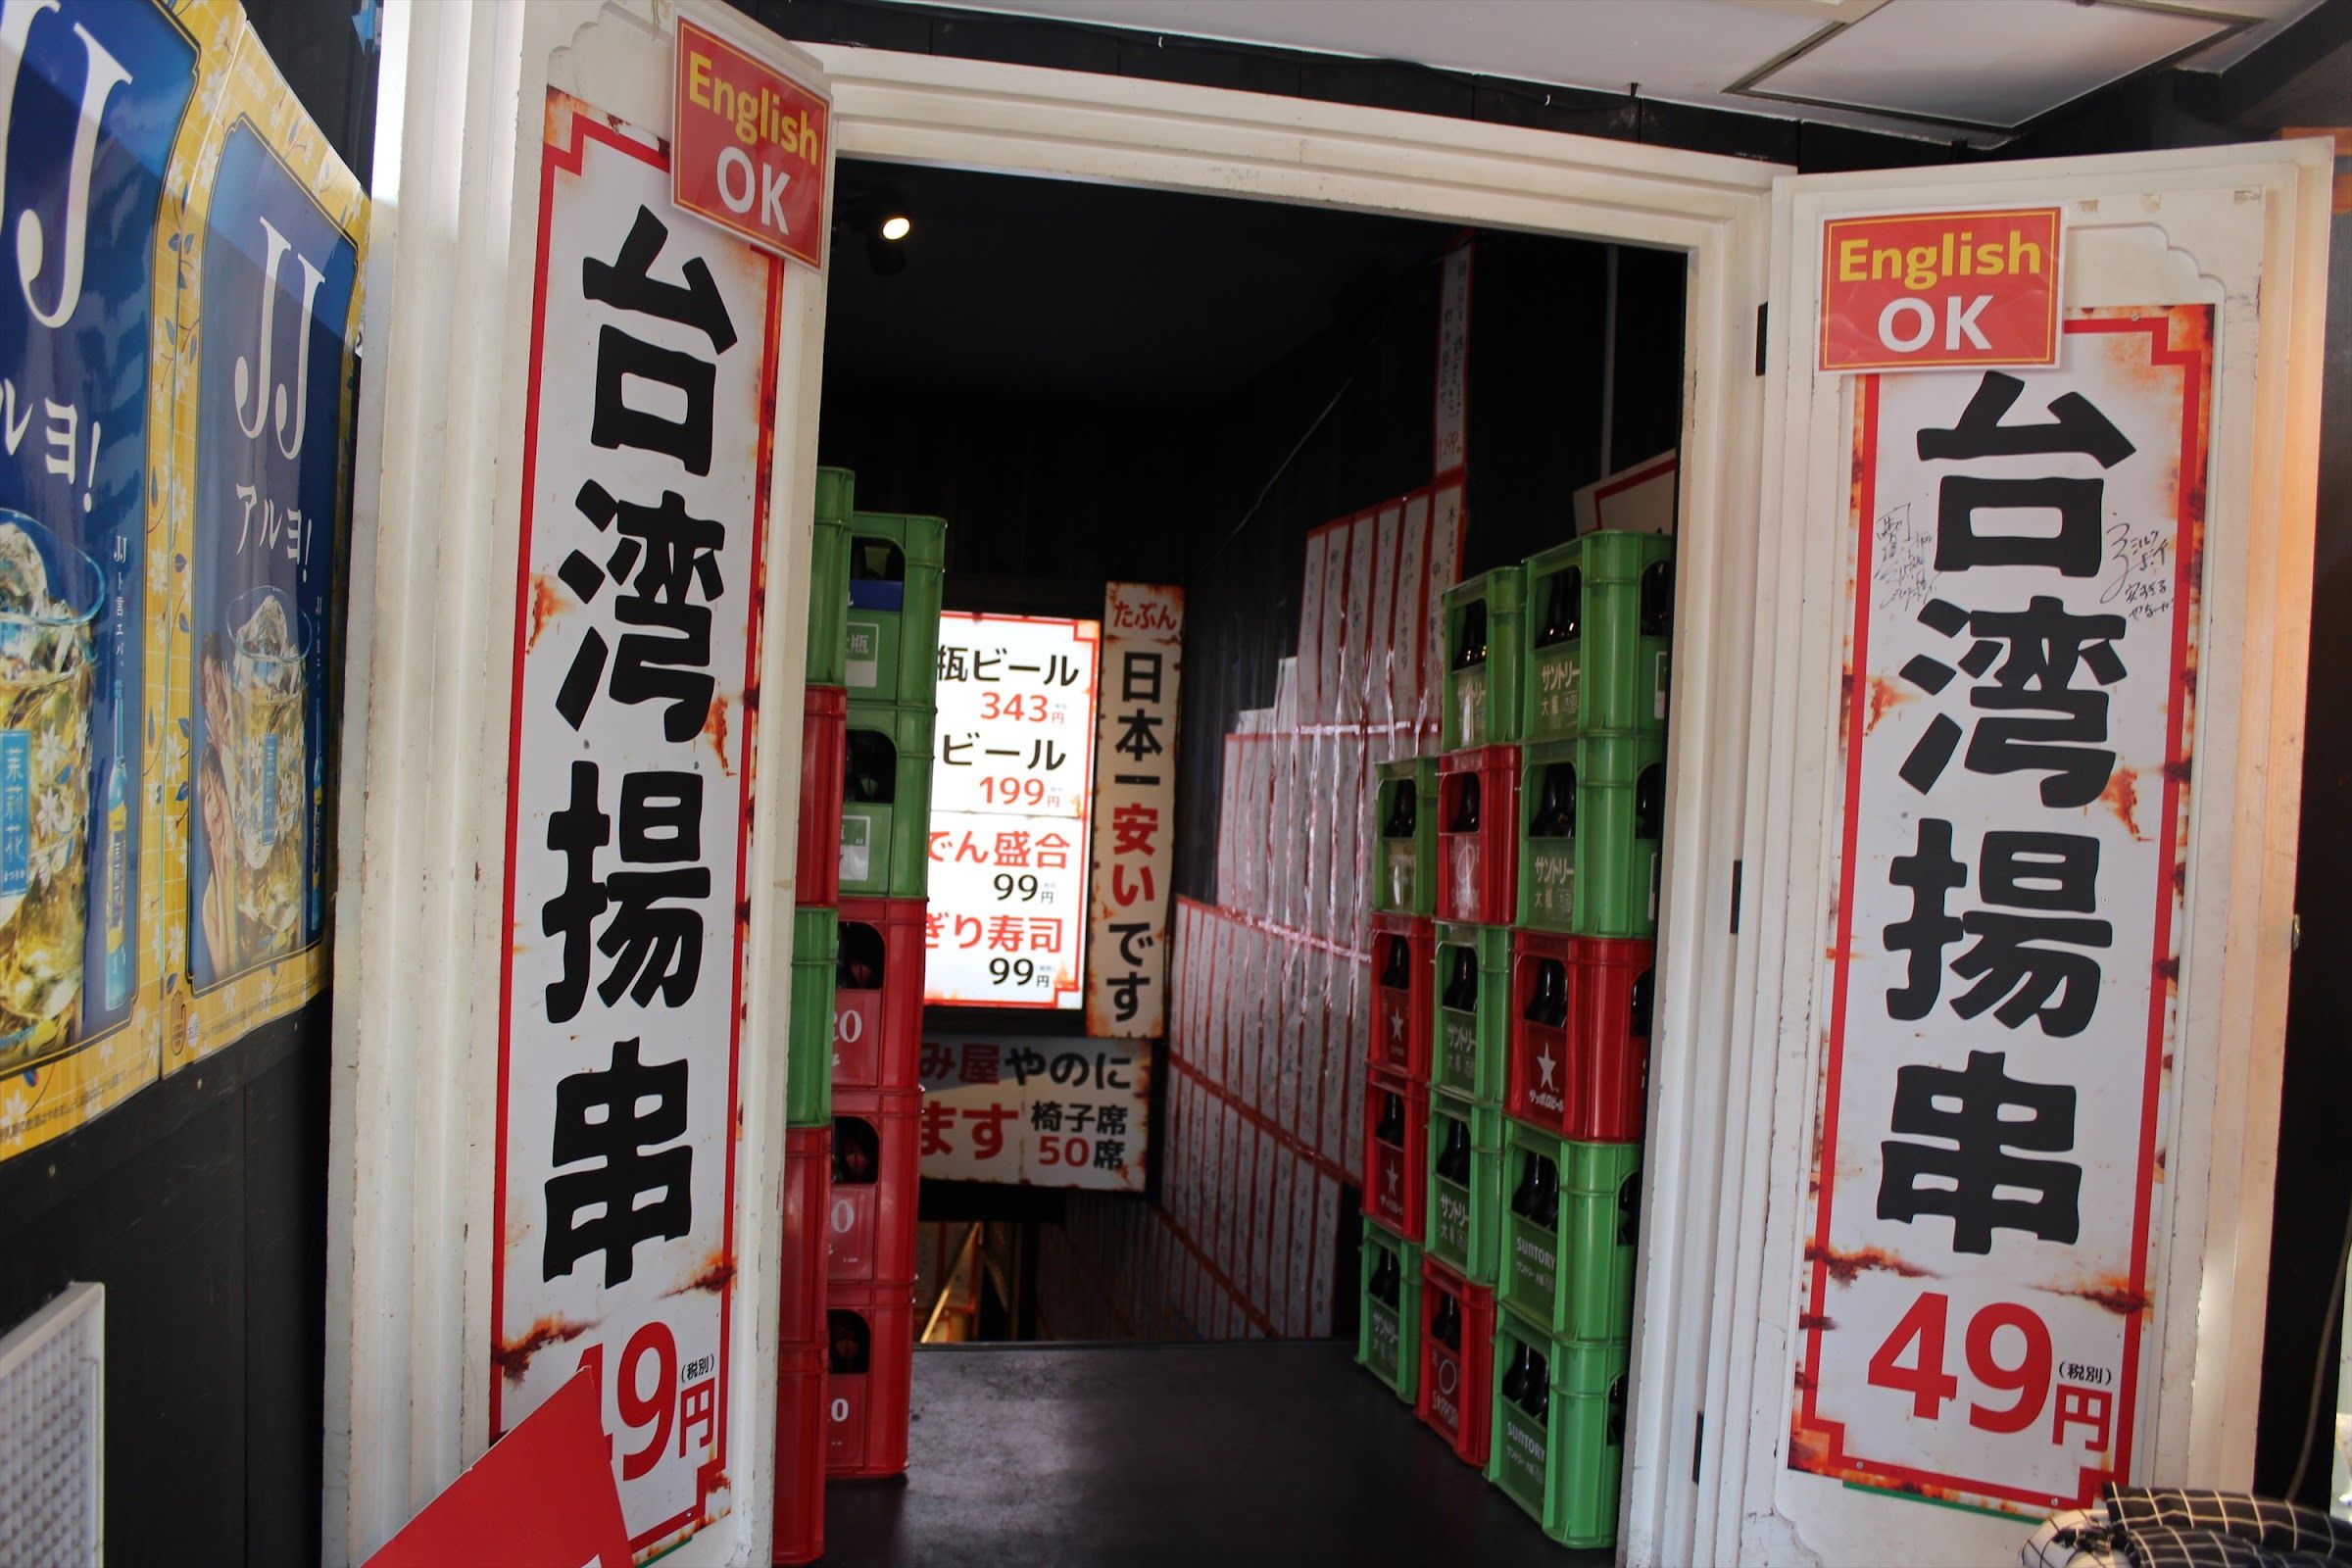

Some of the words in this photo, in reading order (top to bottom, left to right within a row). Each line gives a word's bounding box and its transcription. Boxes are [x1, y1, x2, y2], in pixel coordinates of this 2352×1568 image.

[689, 51, 817, 166] English
[716, 146, 792, 235] OK
[1839, 229, 2040, 290] English
[235, 217, 325, 460] JJ
[1878, 294, 1993, 352] OK
[1113, 600, 1176, 631] たぶん
[938, 644, 1079, 687] 瓶ビール
[1542, 661, 1581, 692] サントリー
[543, 204, 738, 1290] 台湾揚串
[1106, 652, 1162, 1022] 日本一安いです
[1877, 370, 2136, 1254] 台湾揚串
[1031, 1101, 1127, 1137] 椅子席
[1039, 1136, 1125, 1170] 50席
[1516, 1237, 1556, 1269] SUNTORY
[2058, 1360, 2112, 1386] (税別)
[1507, 1421, 1545, 1461] SUNTORY
